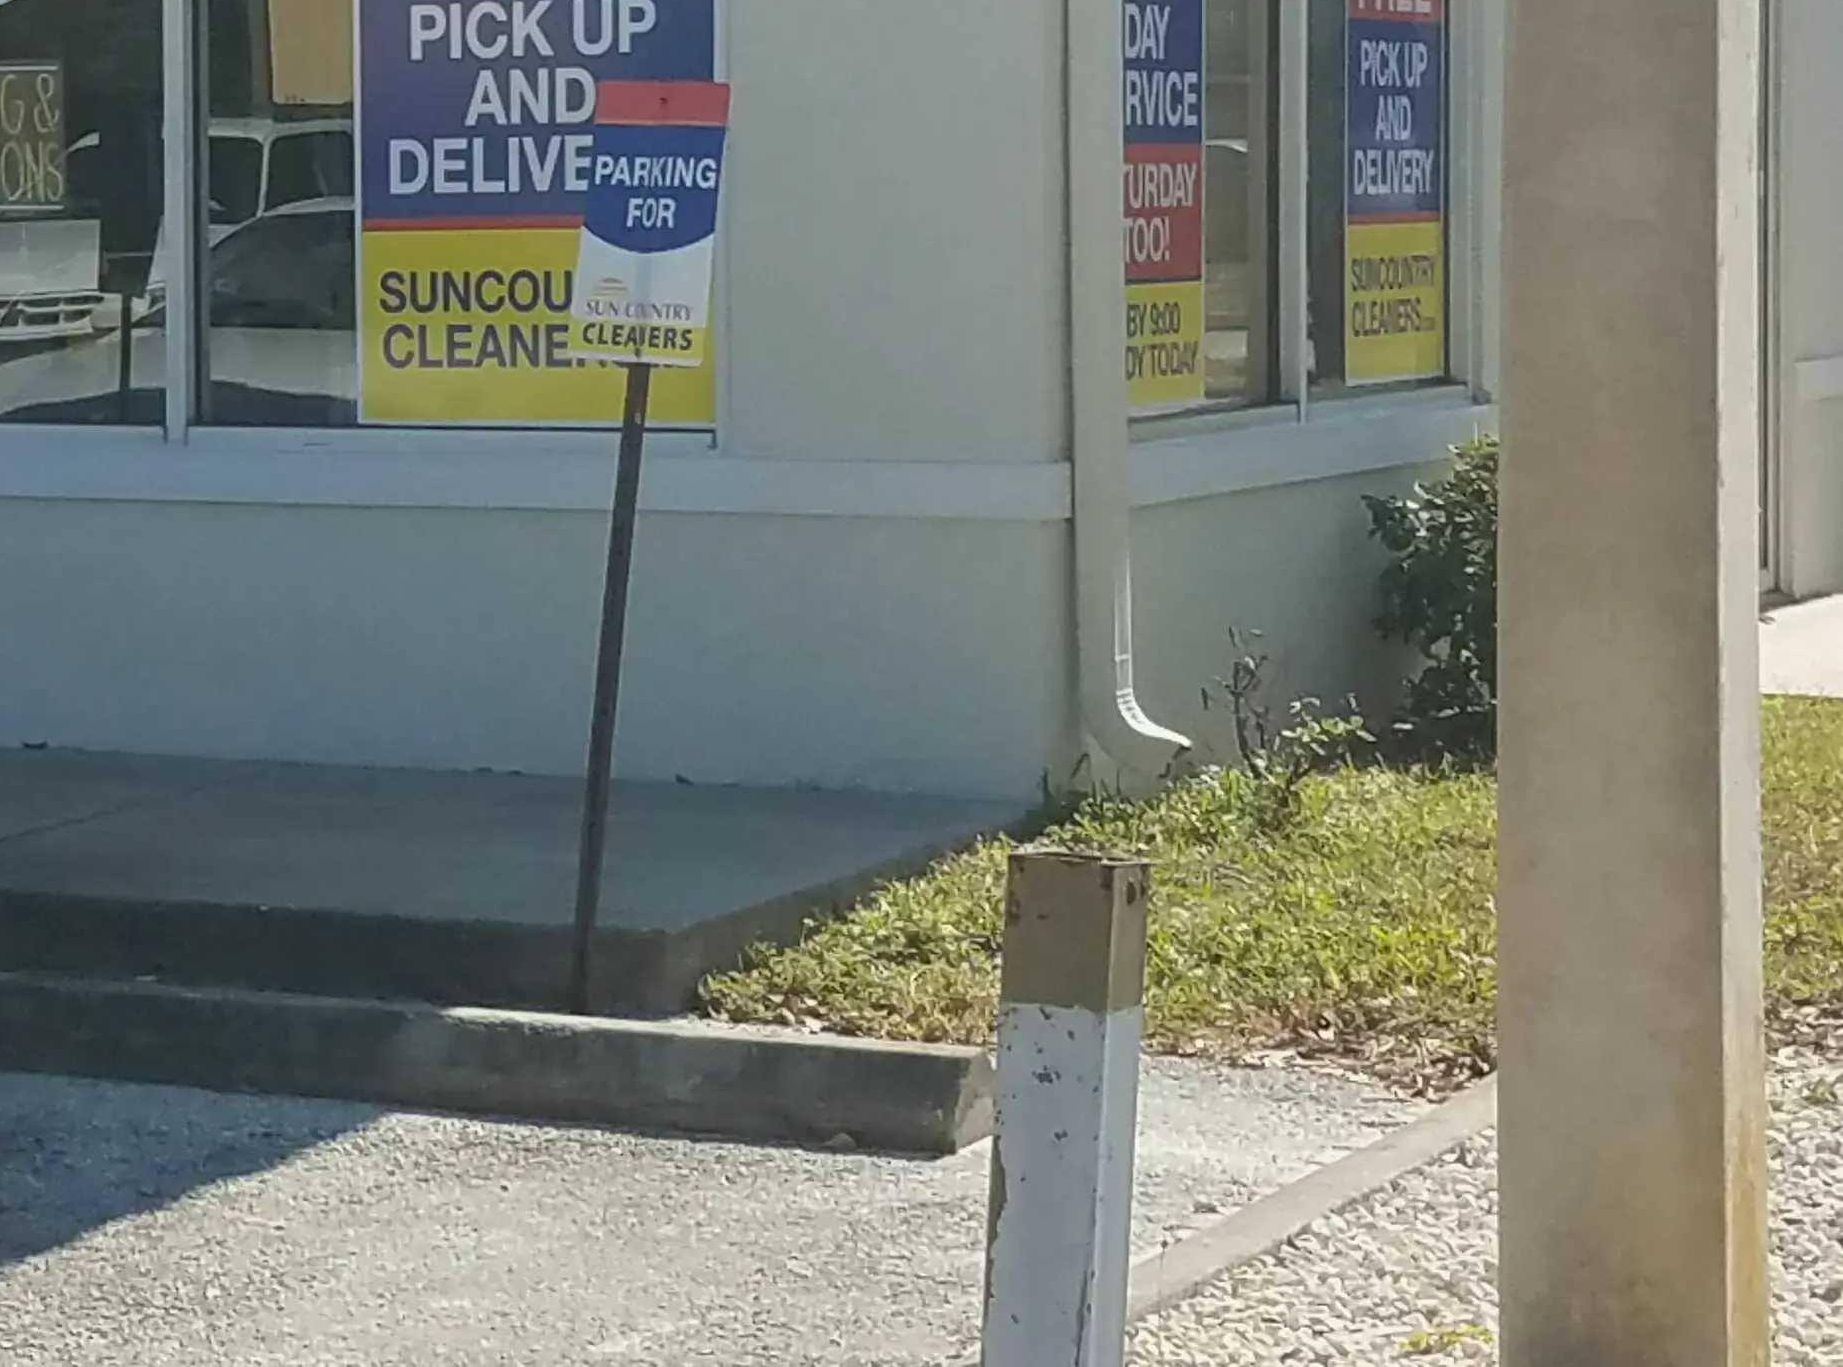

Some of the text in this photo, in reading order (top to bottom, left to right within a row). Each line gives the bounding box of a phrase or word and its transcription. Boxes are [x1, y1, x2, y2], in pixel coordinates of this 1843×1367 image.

[408, 0, 556, 61] PICK
[1124, 2, 1171, 60] DAY
[1360, 39, 1429, 88] PICK UP
[34, 73, 61, 133] &
[464, 67, 598, 128] AND
[1125, 69, 1198, 127] RVICE
[1375, 95, 1412, 141] AND
[387, 134, 595, 197] DELIVE
[594, 155, 718, 190] PARKING
[1353, 148, 1435, 196] DELIVERY
[625, 197, 677, 229] FOR
[378, 269, 574, 315] SUNCOU
[586, 299, 620, 317] SUN
[381, 323, 572, 371] CLEANE
